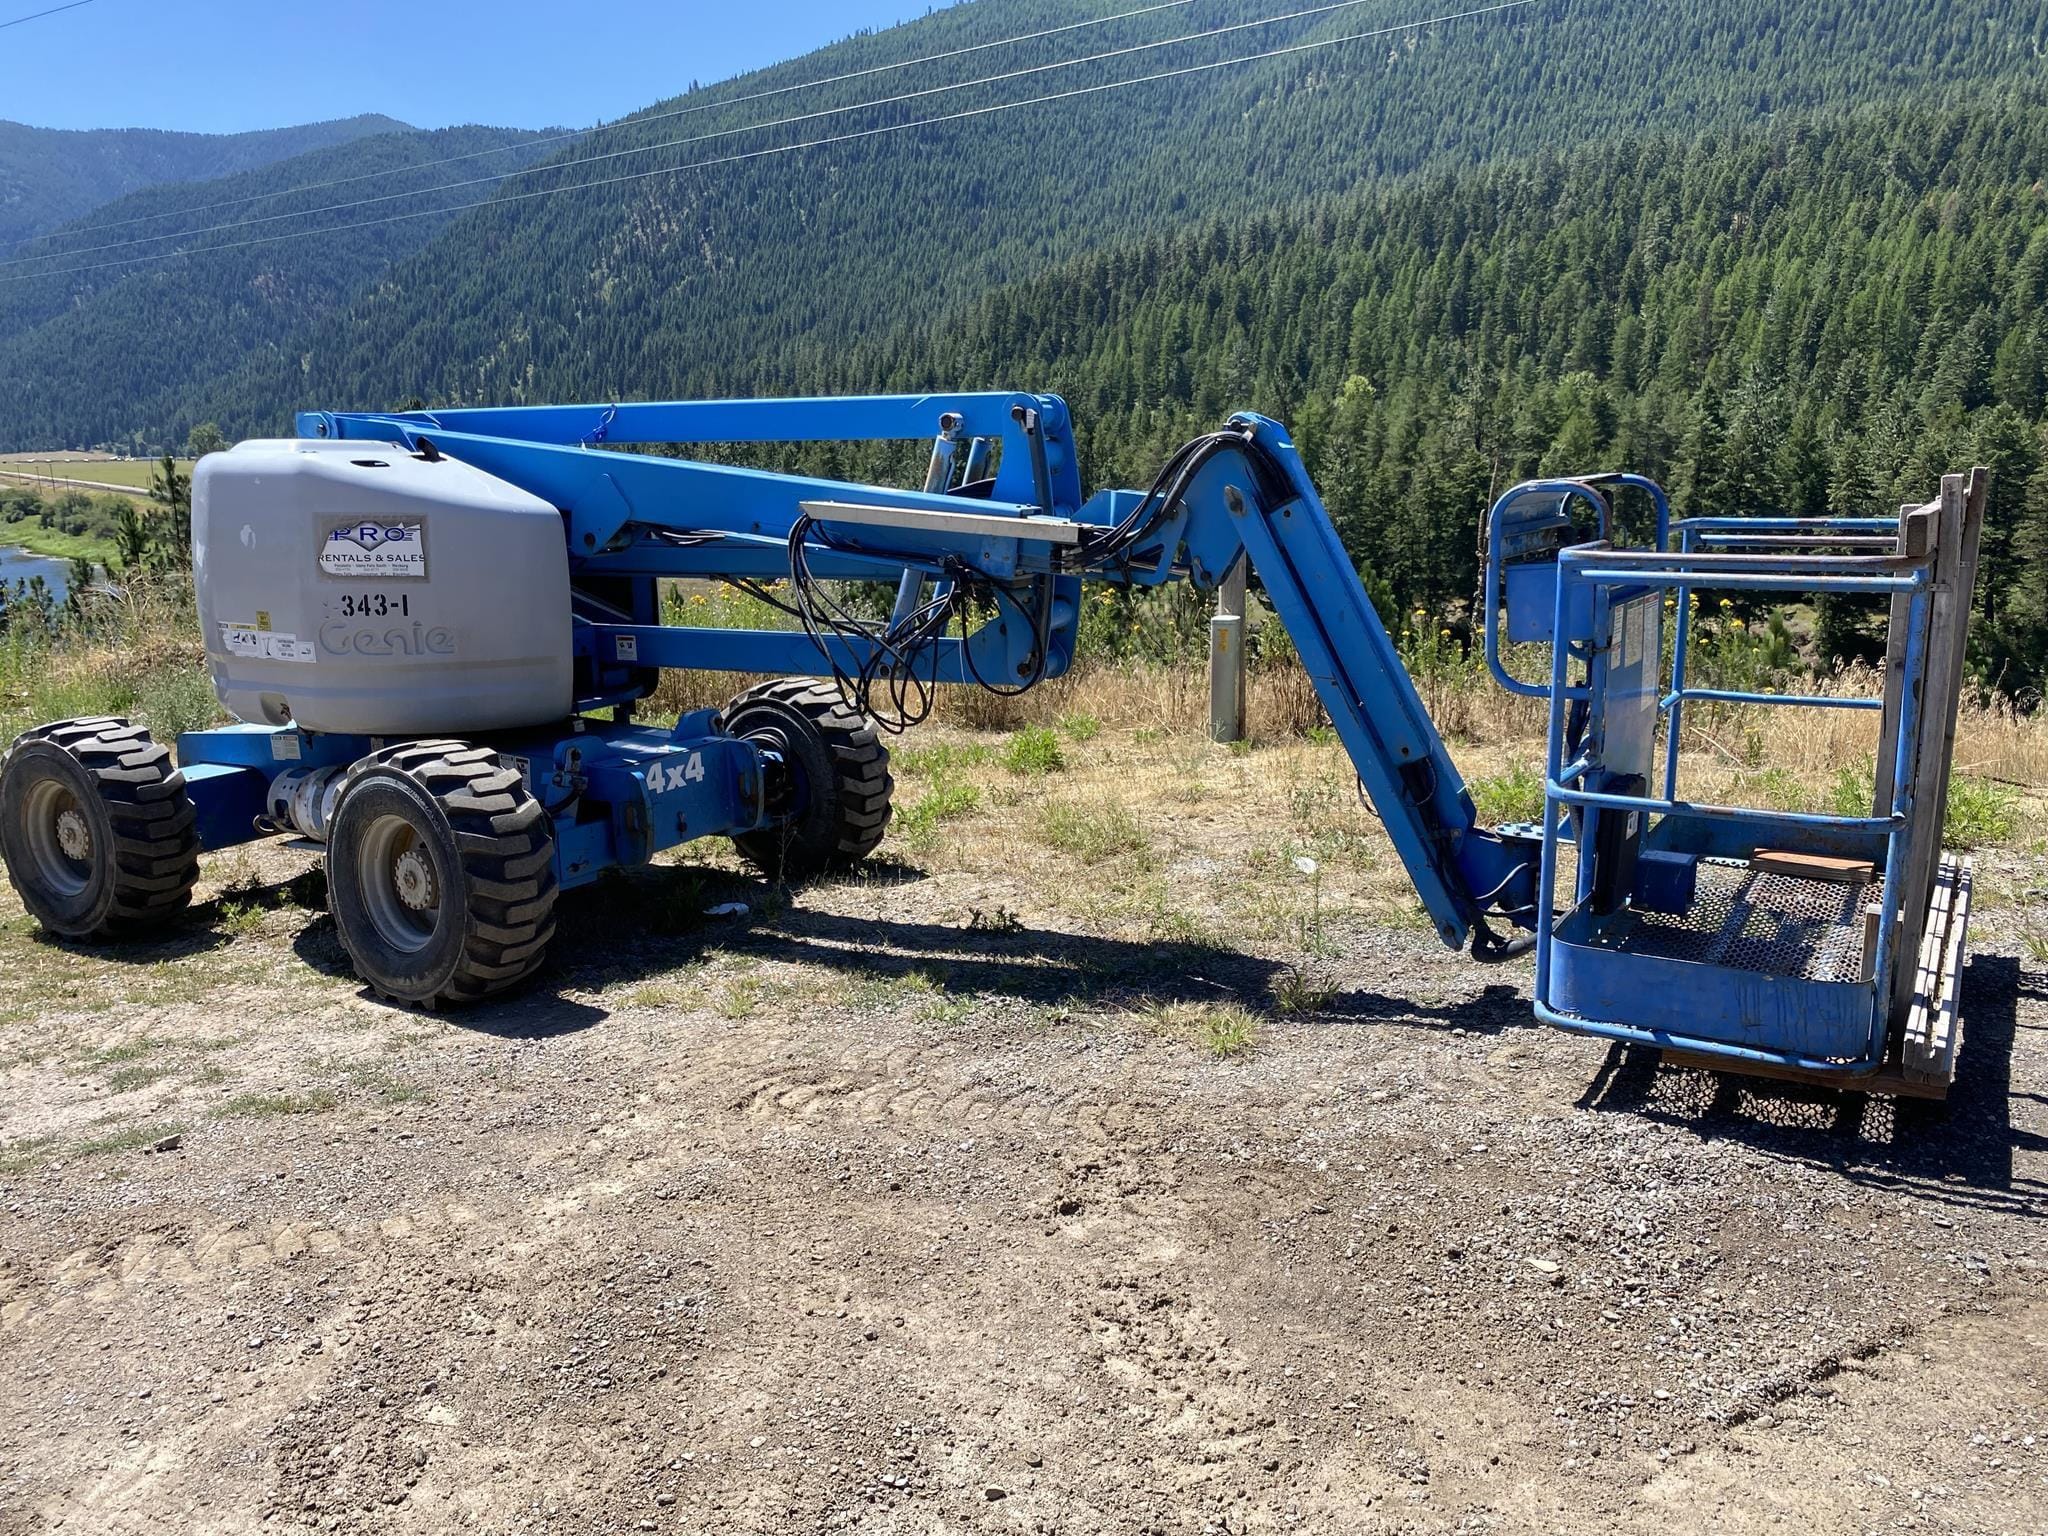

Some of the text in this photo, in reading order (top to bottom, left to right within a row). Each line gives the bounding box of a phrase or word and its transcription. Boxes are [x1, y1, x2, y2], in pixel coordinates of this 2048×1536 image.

[330, 527, 405, 541] PRO
[319, 554, 425, 562] RENTALS & SALES
[319, 620, 455, 656] Genie
[646, 752, 705, 794] 4x4
